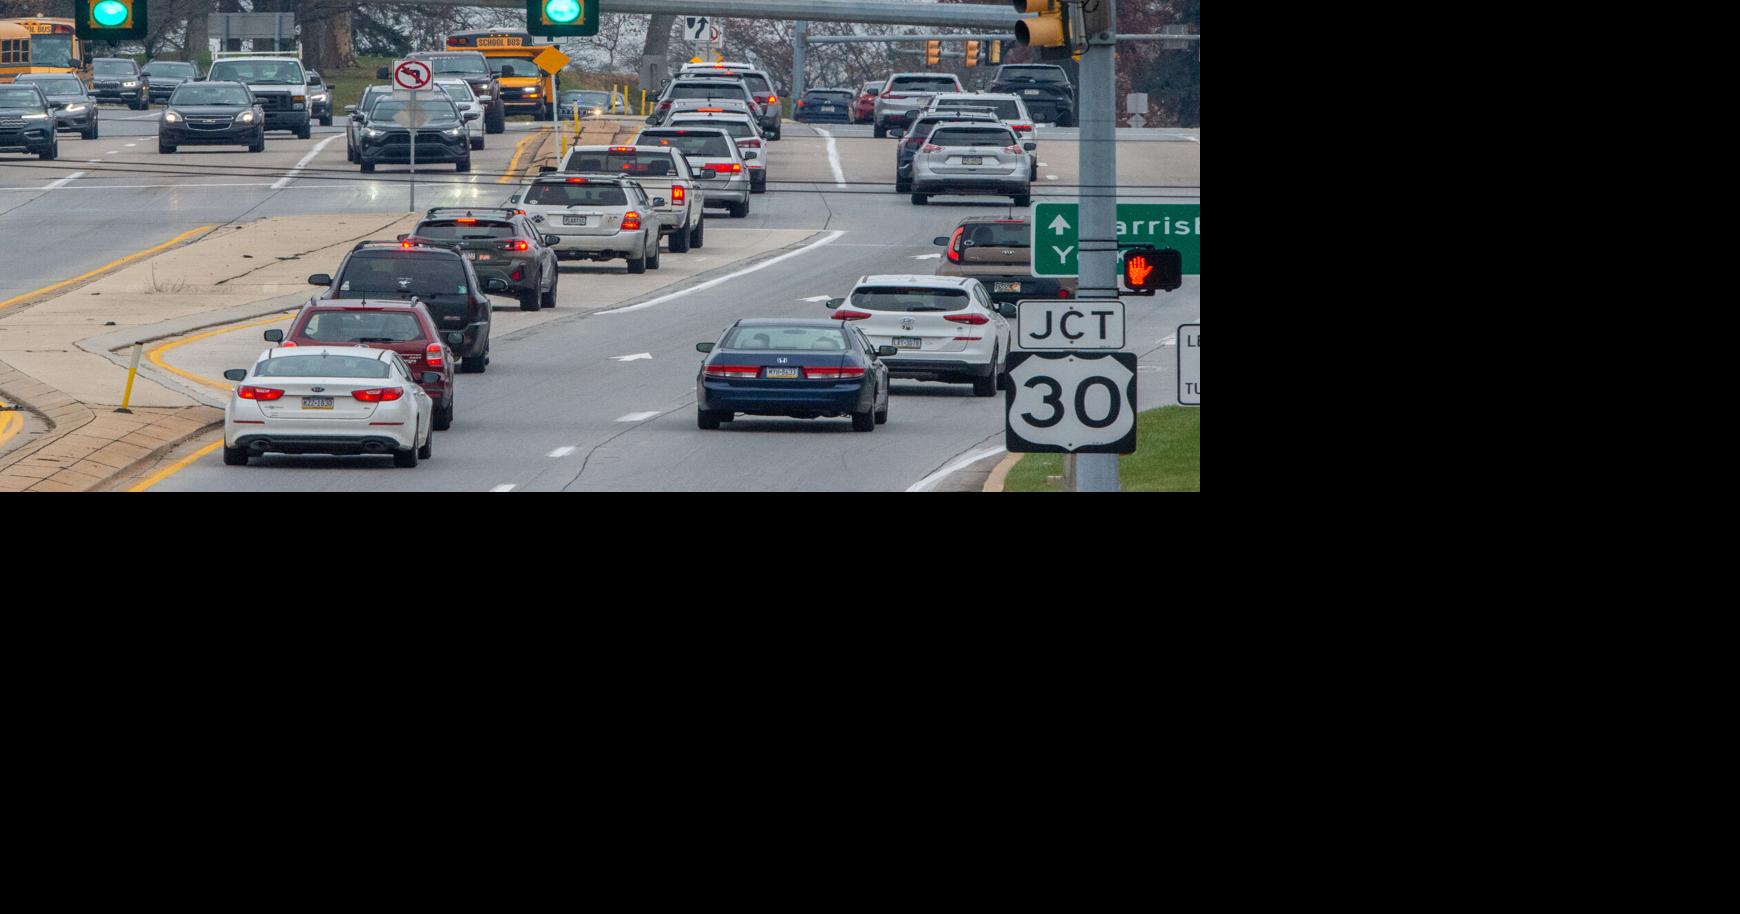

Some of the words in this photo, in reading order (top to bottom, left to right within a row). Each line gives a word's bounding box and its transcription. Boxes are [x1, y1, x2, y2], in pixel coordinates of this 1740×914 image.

[478, 38, 504, 47] SCHOOL
[507, 38, 521, 47] BUS
[1117, 216, 1200, 235] arris
[1028, 310, 1114, 340] JCT
[1021, 375, 1121, 428] 30
